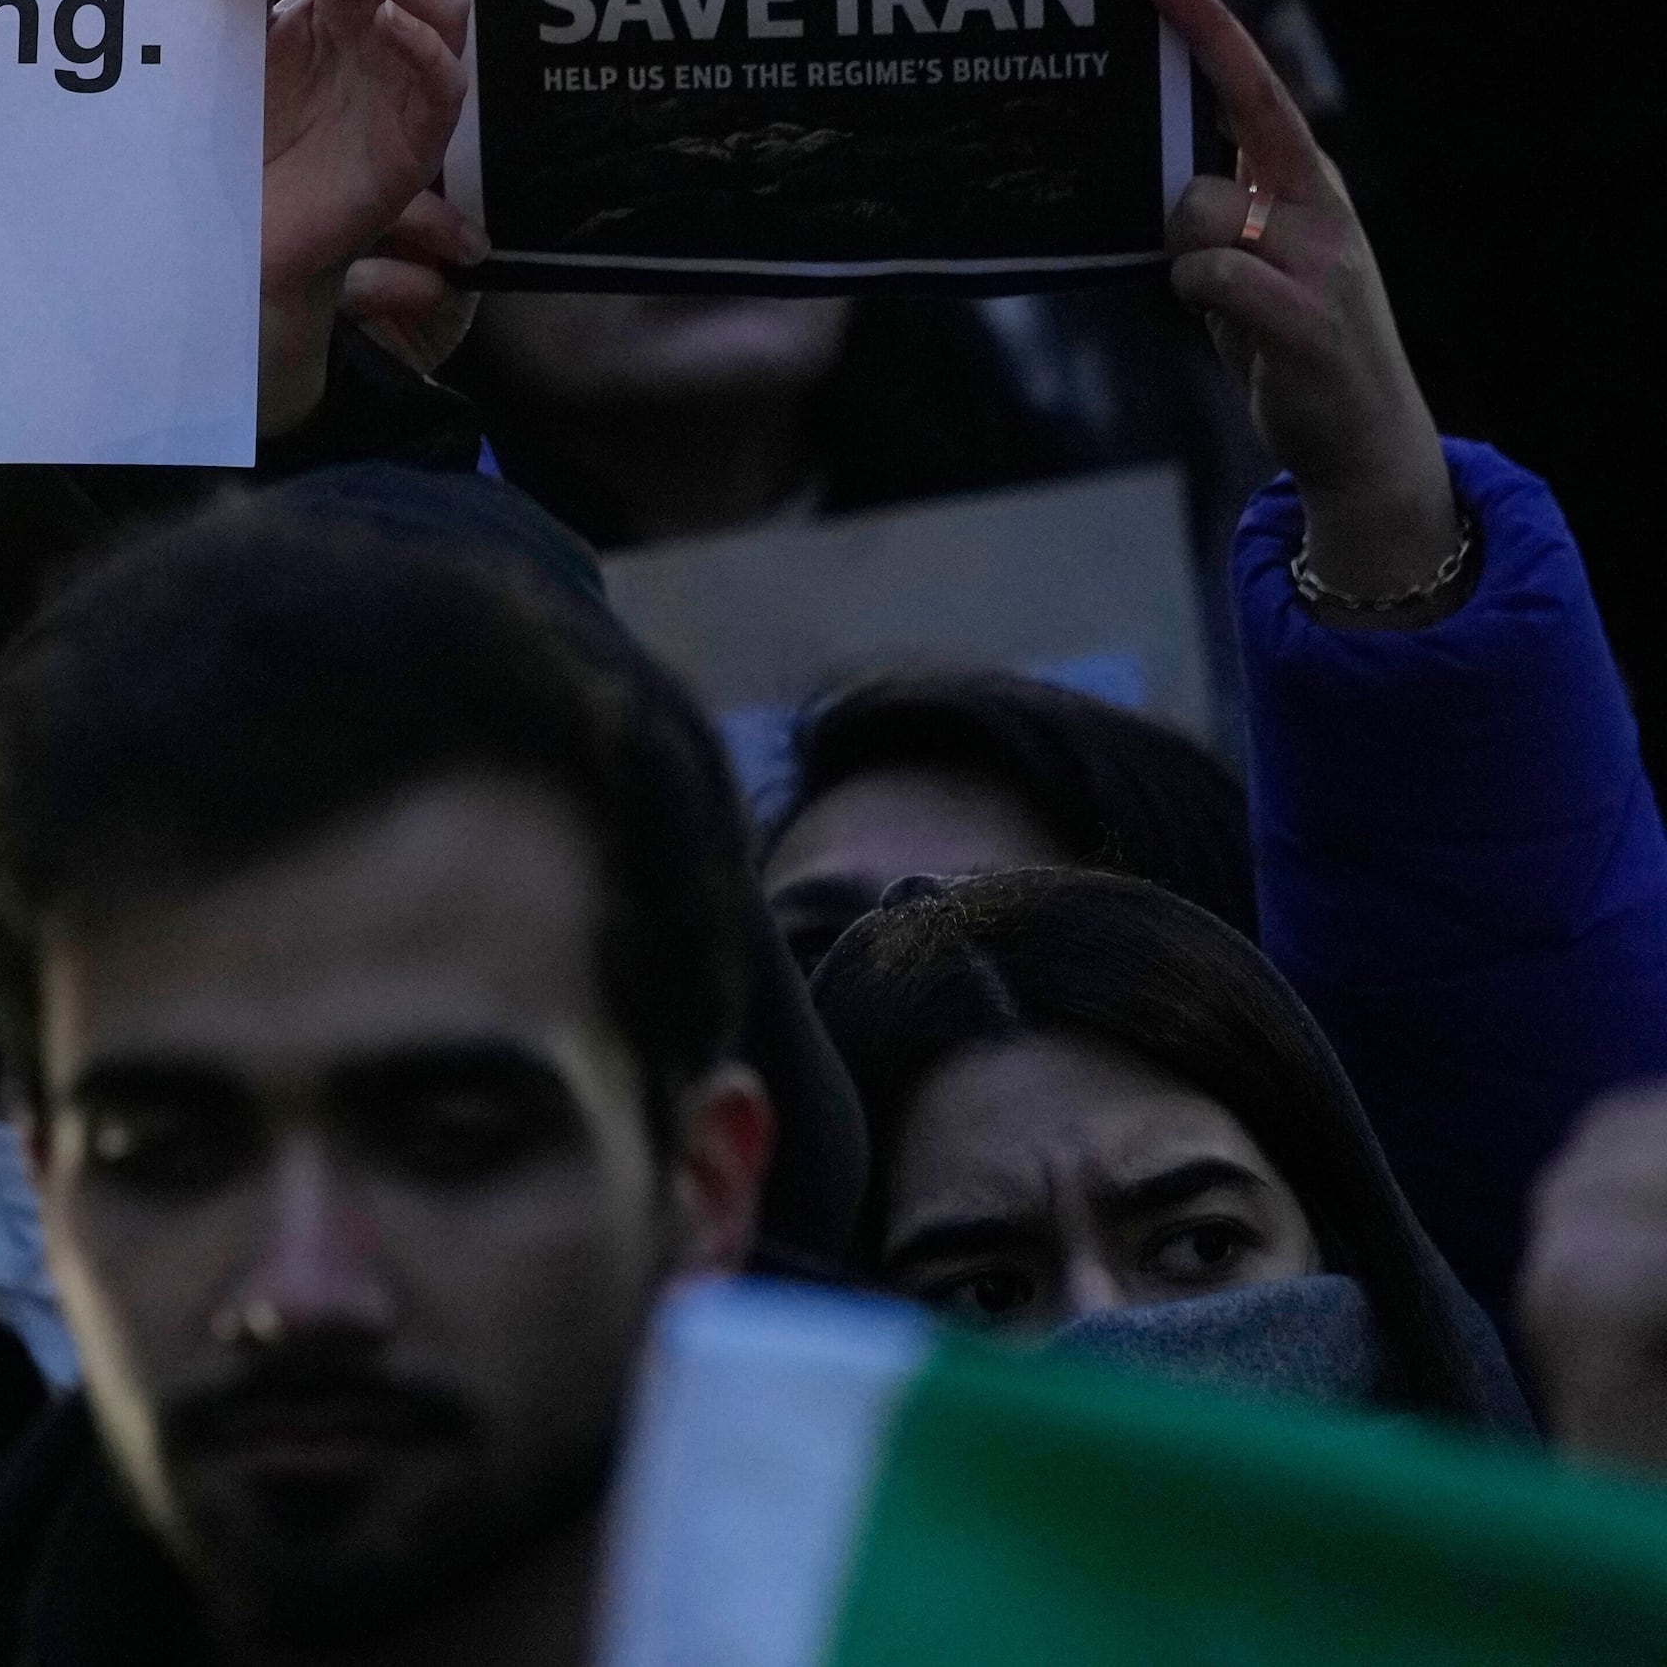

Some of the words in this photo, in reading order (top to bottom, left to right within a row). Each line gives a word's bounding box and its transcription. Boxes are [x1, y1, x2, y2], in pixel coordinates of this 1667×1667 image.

[543, 65, 620, 92] HELP
[627, 64, 666, 91] US
[674, 62, 733, 90] END
[742, 60, 799, 88] THE
[806, 57, 944, 88] REGIME'S
[952, 50, 1109, 84] BRUTALITY
